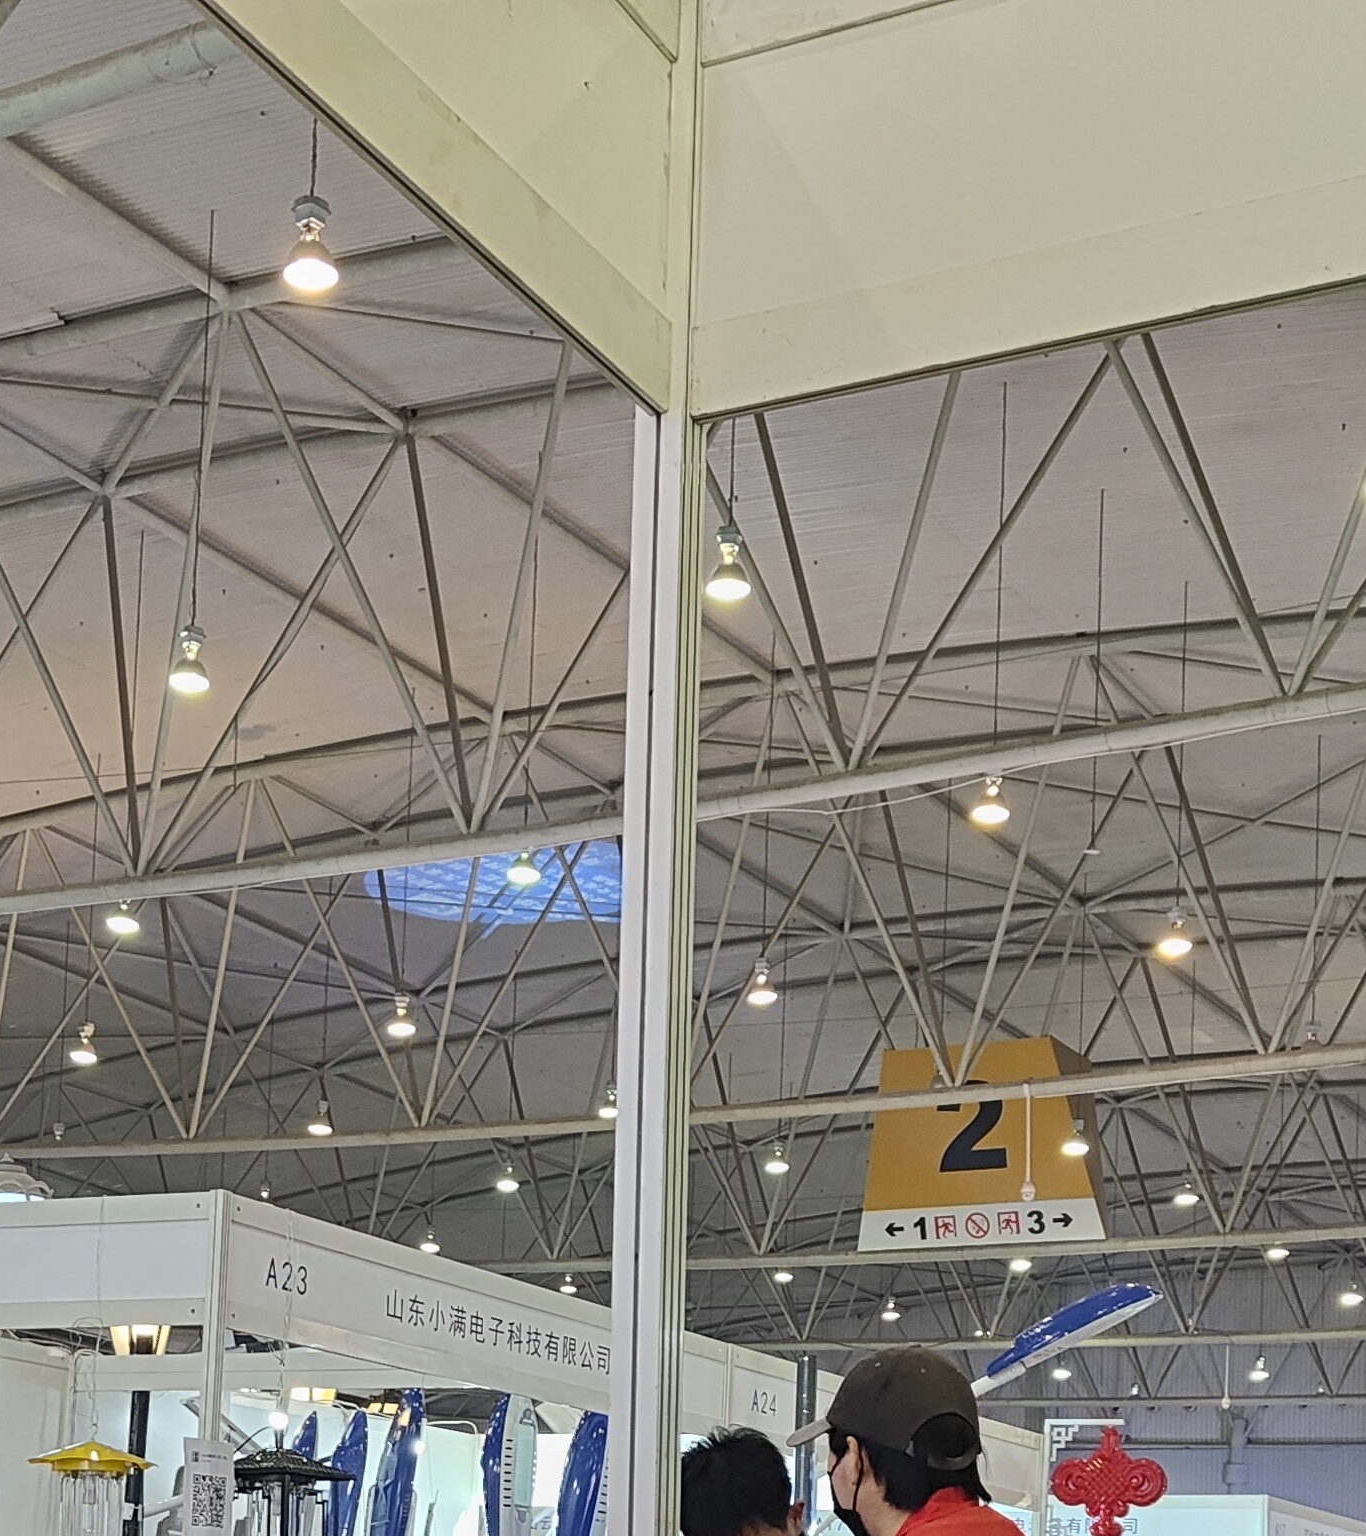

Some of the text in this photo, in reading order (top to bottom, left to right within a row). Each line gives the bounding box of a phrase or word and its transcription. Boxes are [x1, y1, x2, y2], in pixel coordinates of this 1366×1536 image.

[937, 1079, 1008, 1173] 2
[913, 1216, 928, 1240] 1
[1027, 1210, 1046, 1234] 3
[265, 1257, 308, 1296] A23
[386, 1288, 611, 1375] 山东小满电子科技有限公司
[751, 1389, 777, 1416] A24
